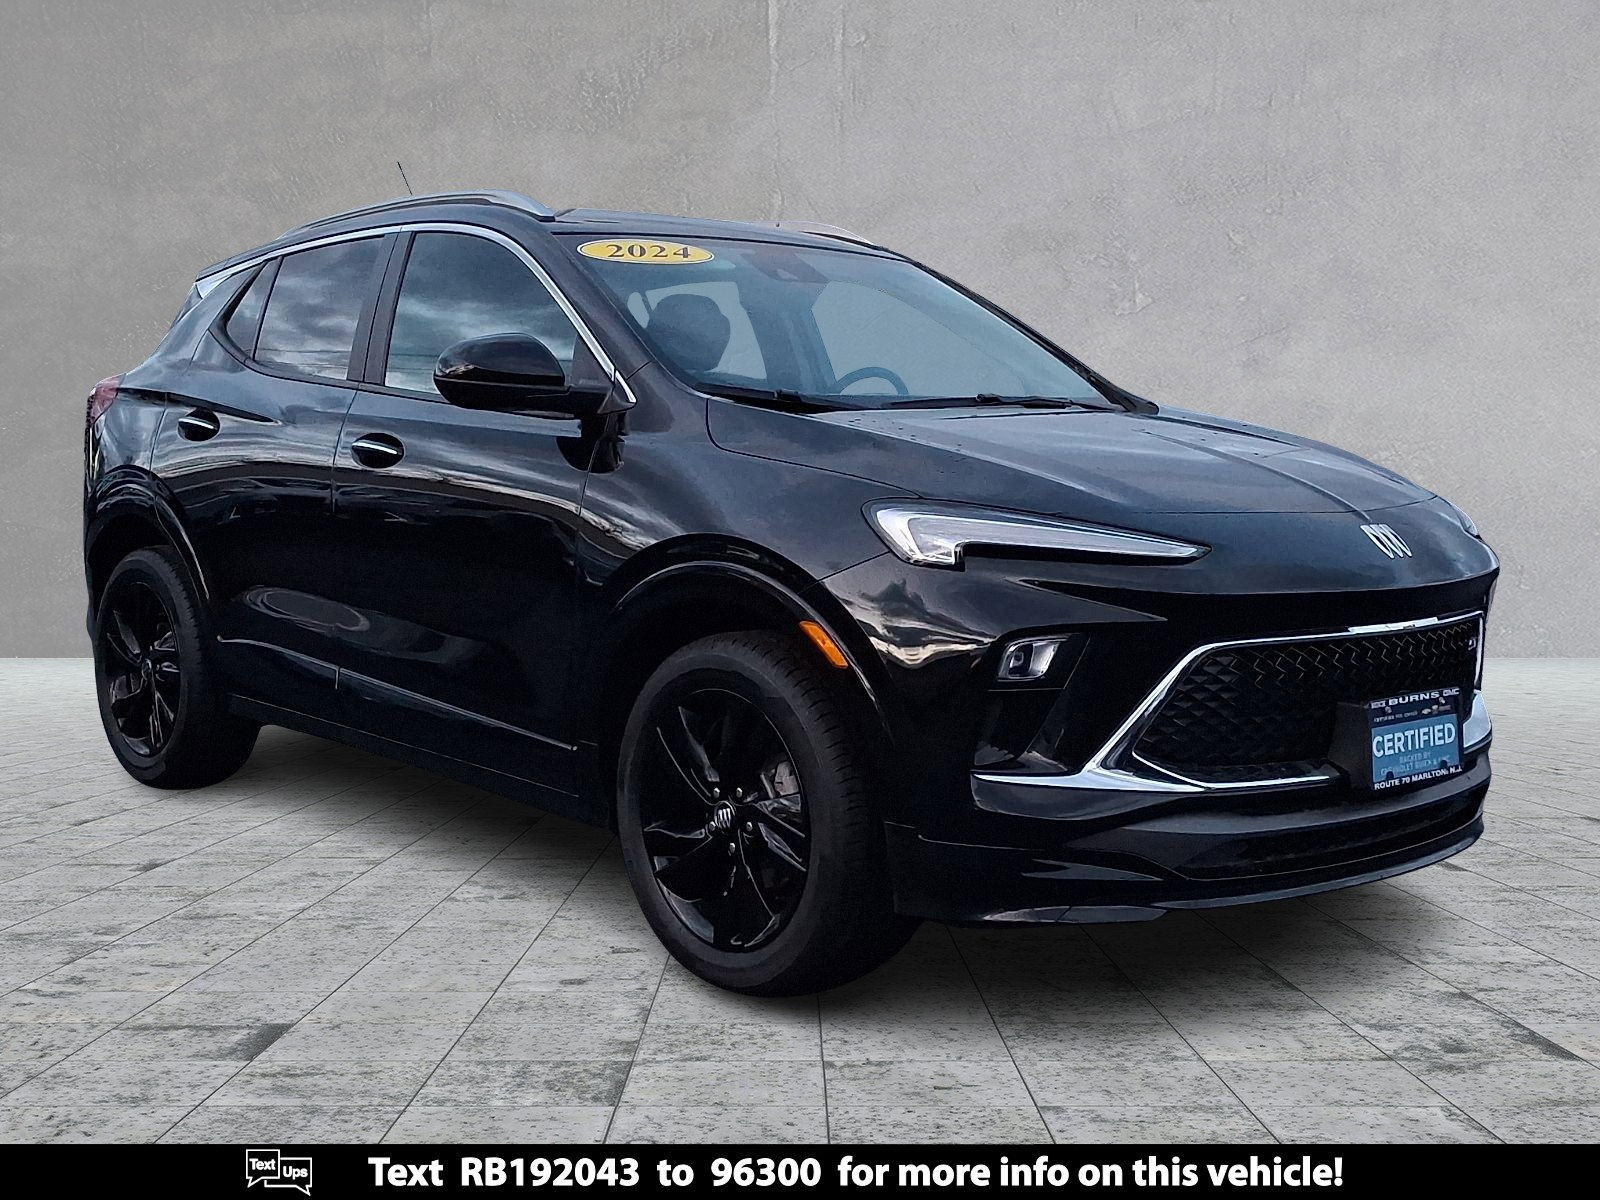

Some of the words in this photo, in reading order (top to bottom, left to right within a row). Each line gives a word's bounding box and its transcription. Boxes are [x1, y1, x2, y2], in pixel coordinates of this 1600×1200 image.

[606, 244, 692, 259] 2024
[1388, 691, 1440, 706] BURNS
[1372, 722, 1456, 758] CERTIFIED
[1374, 779, 1400, 790] ROUTE
[1402, 777, 1410, 785] 70
